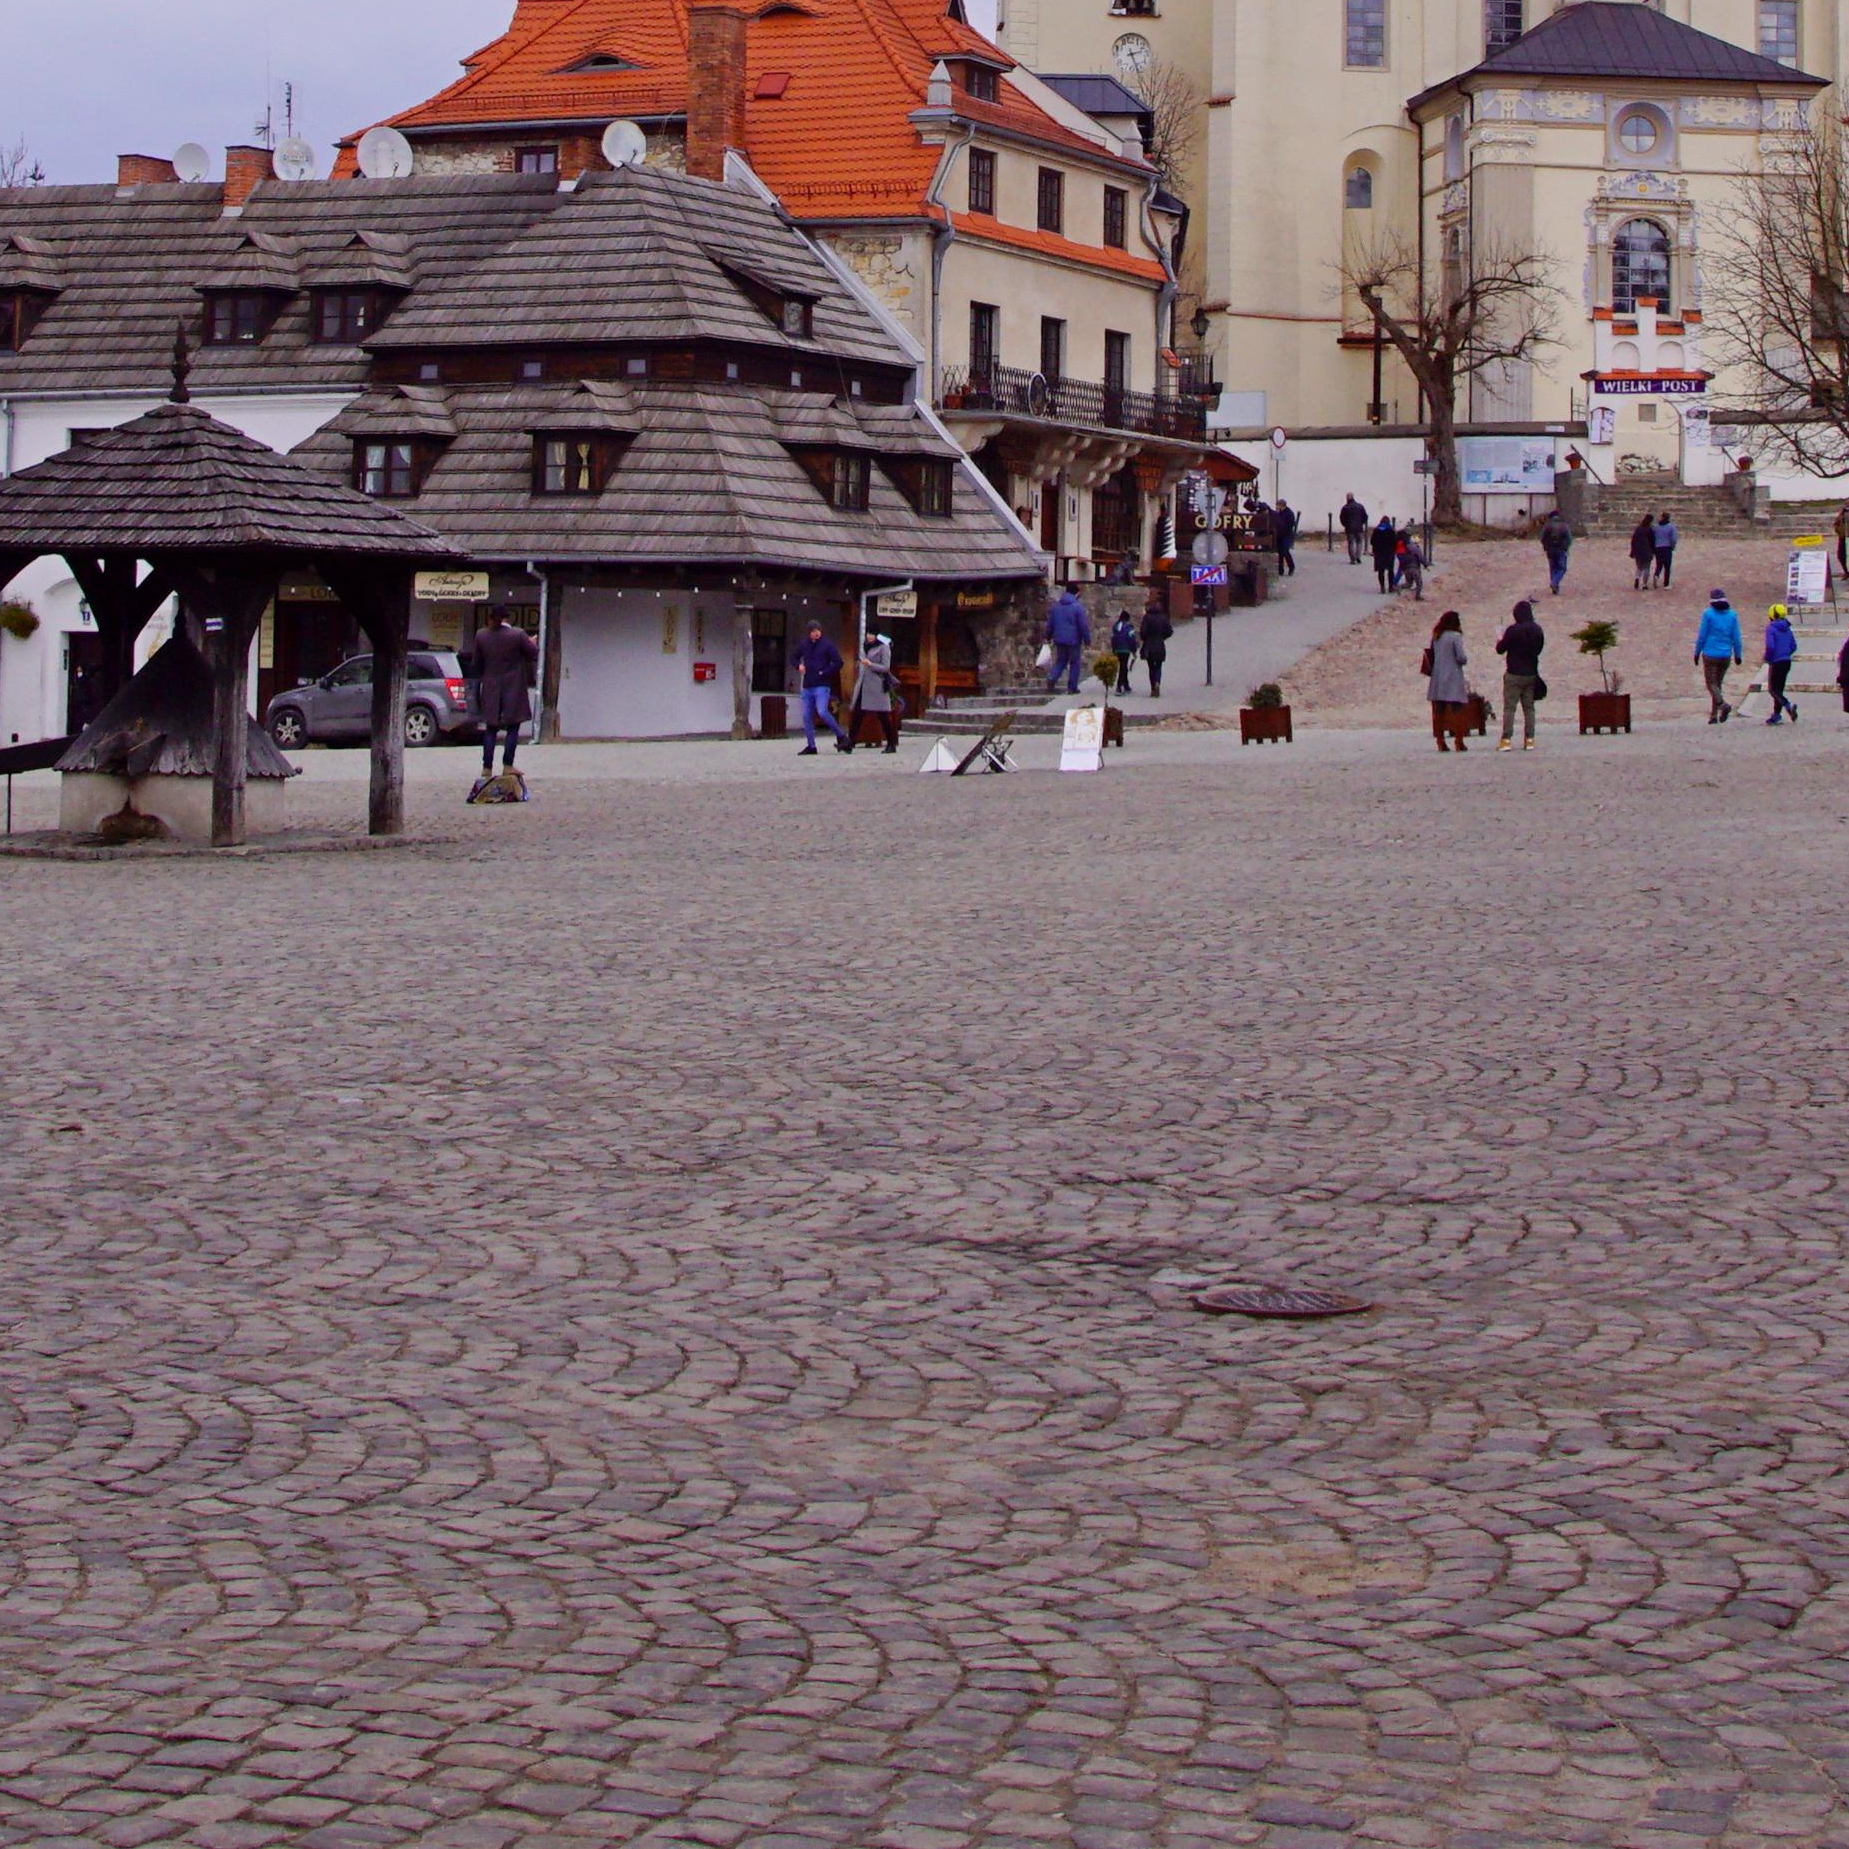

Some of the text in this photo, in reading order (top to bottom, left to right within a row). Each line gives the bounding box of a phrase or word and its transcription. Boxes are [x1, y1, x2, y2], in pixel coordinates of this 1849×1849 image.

[1602, 380, 1698, 393] WIELKI POST
[1193, 566, 1225, 583] TAXI
